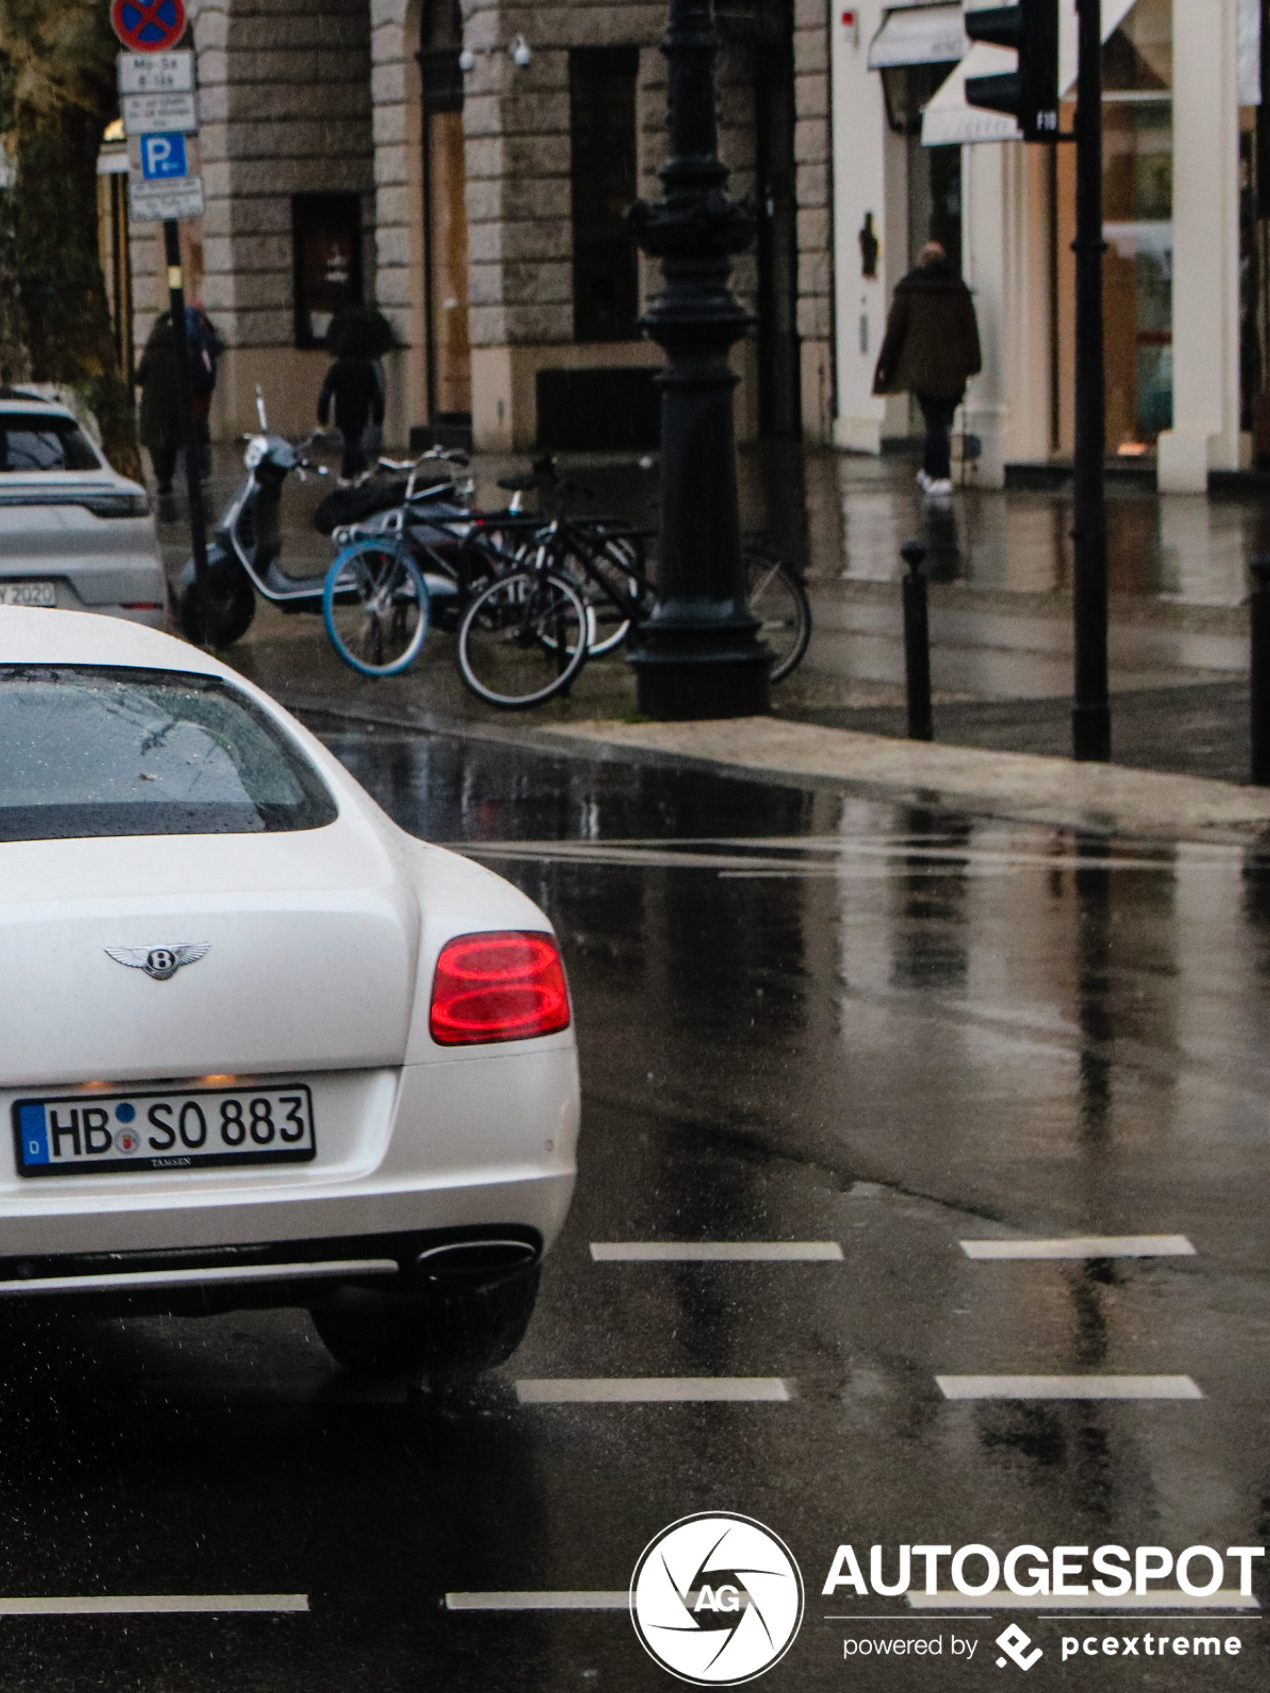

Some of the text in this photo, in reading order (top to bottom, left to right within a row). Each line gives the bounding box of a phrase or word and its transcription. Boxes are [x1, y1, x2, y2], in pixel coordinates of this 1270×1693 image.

[146, 137, 171, 174] P
[49, 1096, 304, 1157] HB SO 883
[29, 1140, 40, 1155] D
[151, 1156, 192, 1167] TAMSEN
